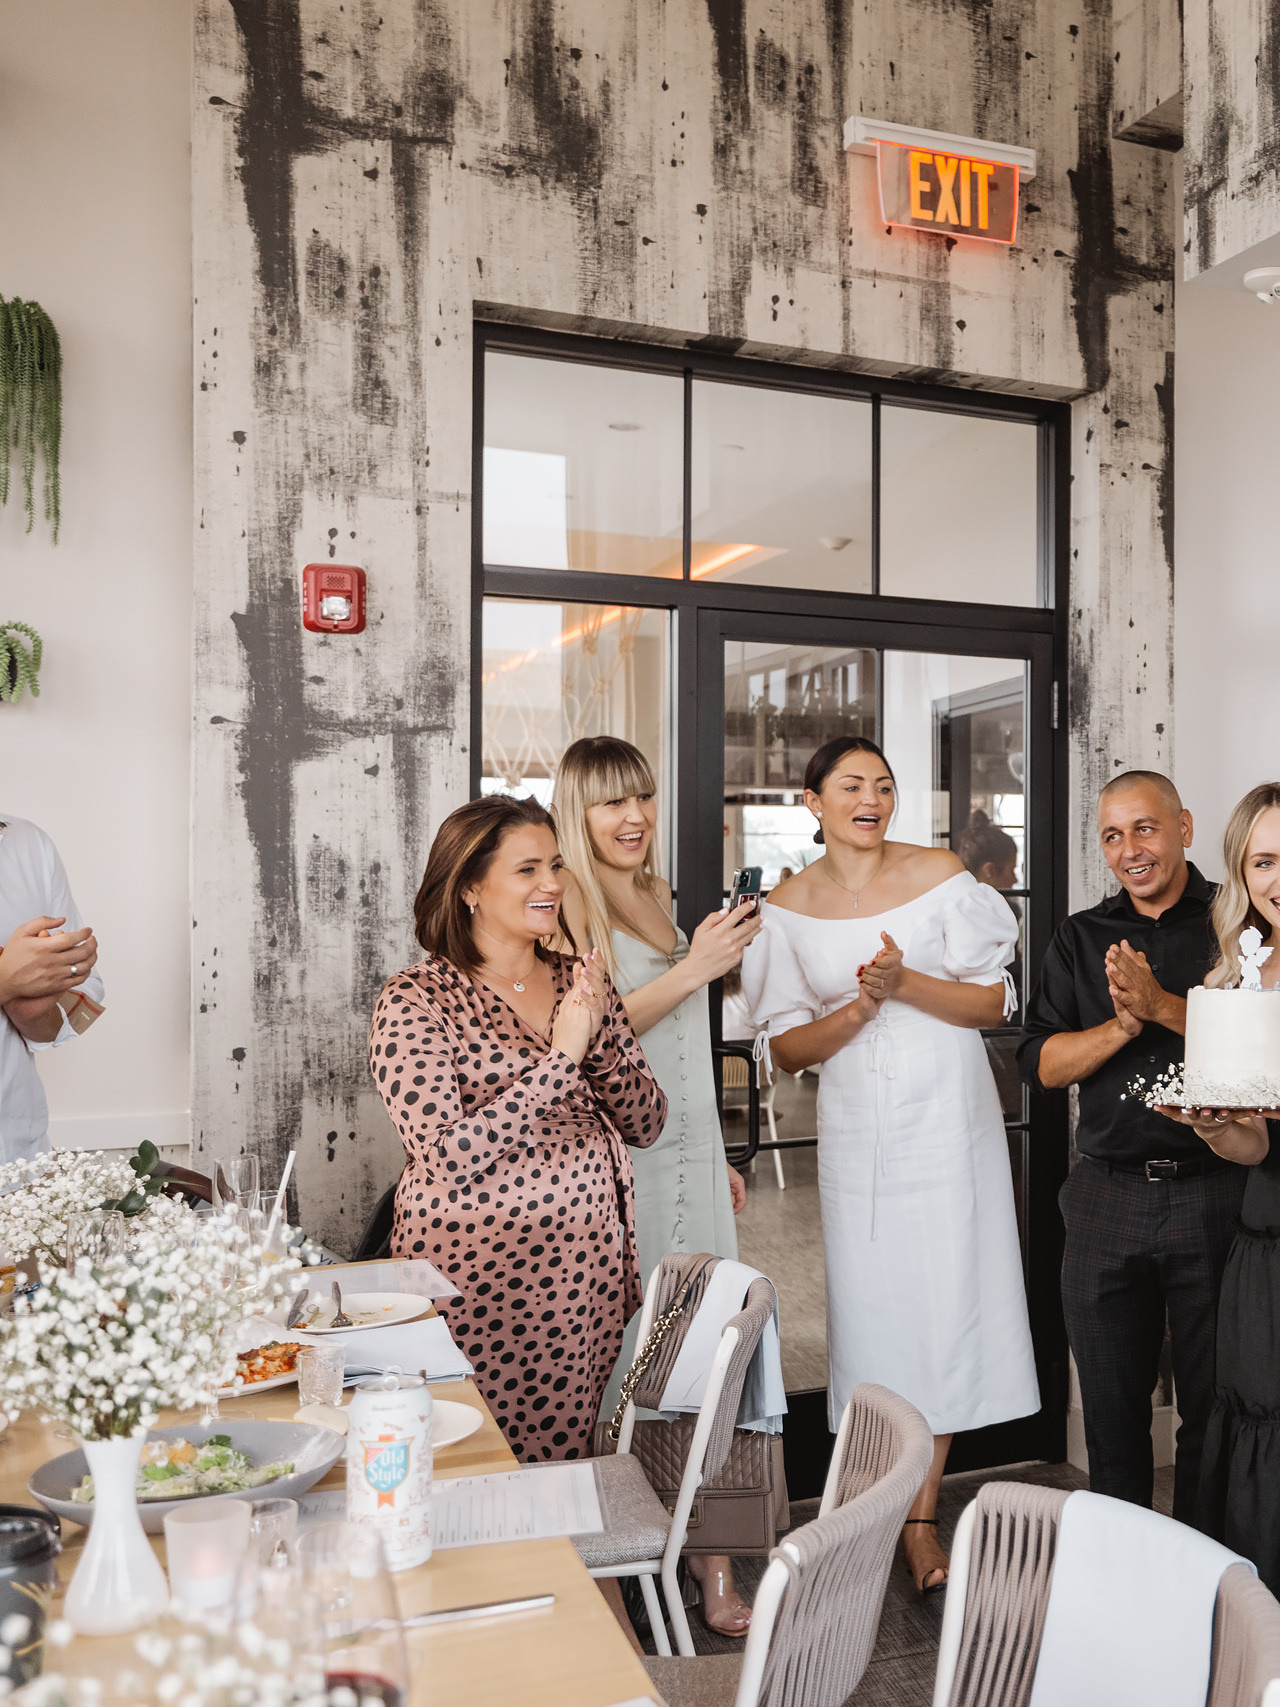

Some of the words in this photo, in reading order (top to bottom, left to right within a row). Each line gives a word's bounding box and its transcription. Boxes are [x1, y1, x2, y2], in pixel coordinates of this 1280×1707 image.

[909, 150, 995, 230] EXIT
[380, 1448, 405, 1467] Old
[368, 1462, 406, 1488] Style
